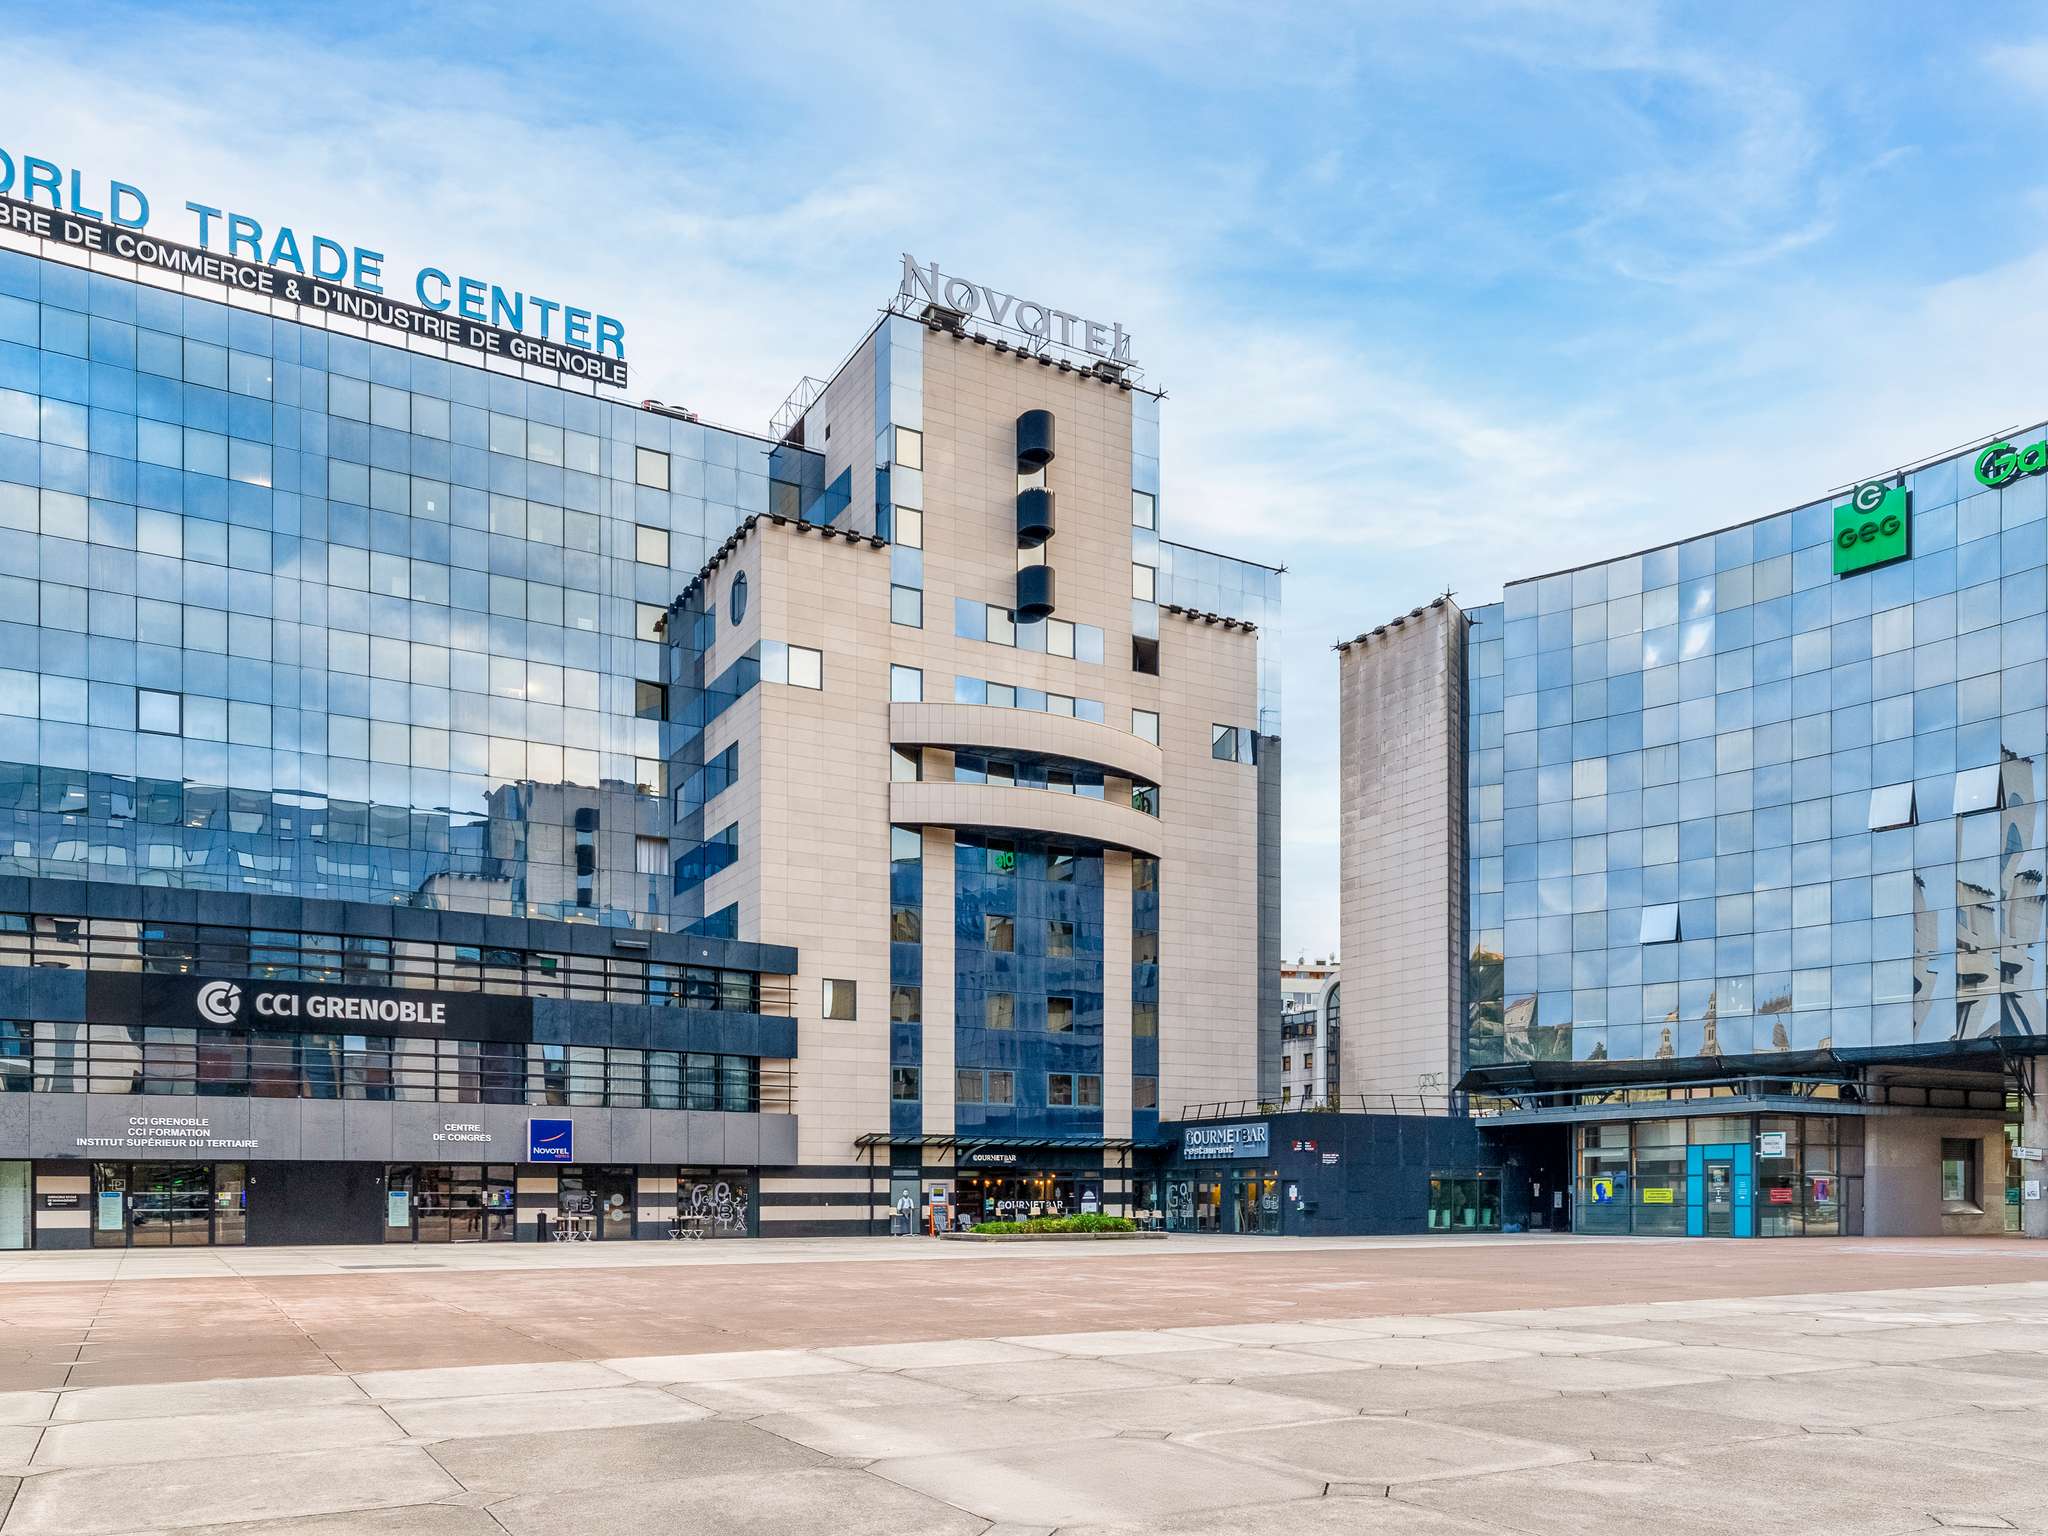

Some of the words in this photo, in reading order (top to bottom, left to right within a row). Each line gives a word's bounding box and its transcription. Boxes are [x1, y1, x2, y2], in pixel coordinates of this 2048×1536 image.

[186, 200, 384, 295] TRADE
[416, 267, 625, 359] CENTER
[64, 220, 101, 250] DE
[115, 234, 273, 294] COMMERCE
[285, 280, 301, 301] &
[313, 286, 460, 342] D'INDUSTRIE
[470, 327, 500, 353] DE
[510, 338, 627, 385] GRENOBLE
[902, 252, 1138, 366] NOVOTEL
[255, 992, 299, 1017] CCI
[306, 995, 446, 1024] GRENOBLE
[129, 1117, 148, 1126] CCI
[150, 1117, 209, 1126] GRENOBLE
[128, 1128, 146, 1136] CCI
[149, 1128, 210, 1137] FORMATION
[444, 1123, 480, 1132] CENTRE
[76, 1138, 124, 1146] INSTITUT
[126, 1136, 186, 1147] SUPÉRIEUR
[189, 1139, 204, 1147] DU
[207, 1140, 259, 1148] TERTIAIRE
[433, 1133, 445, 1141] DE
[533, 1147, 569, 1155] NOVOTEL
[1184, 1145, 1235, 1155] restaurant
